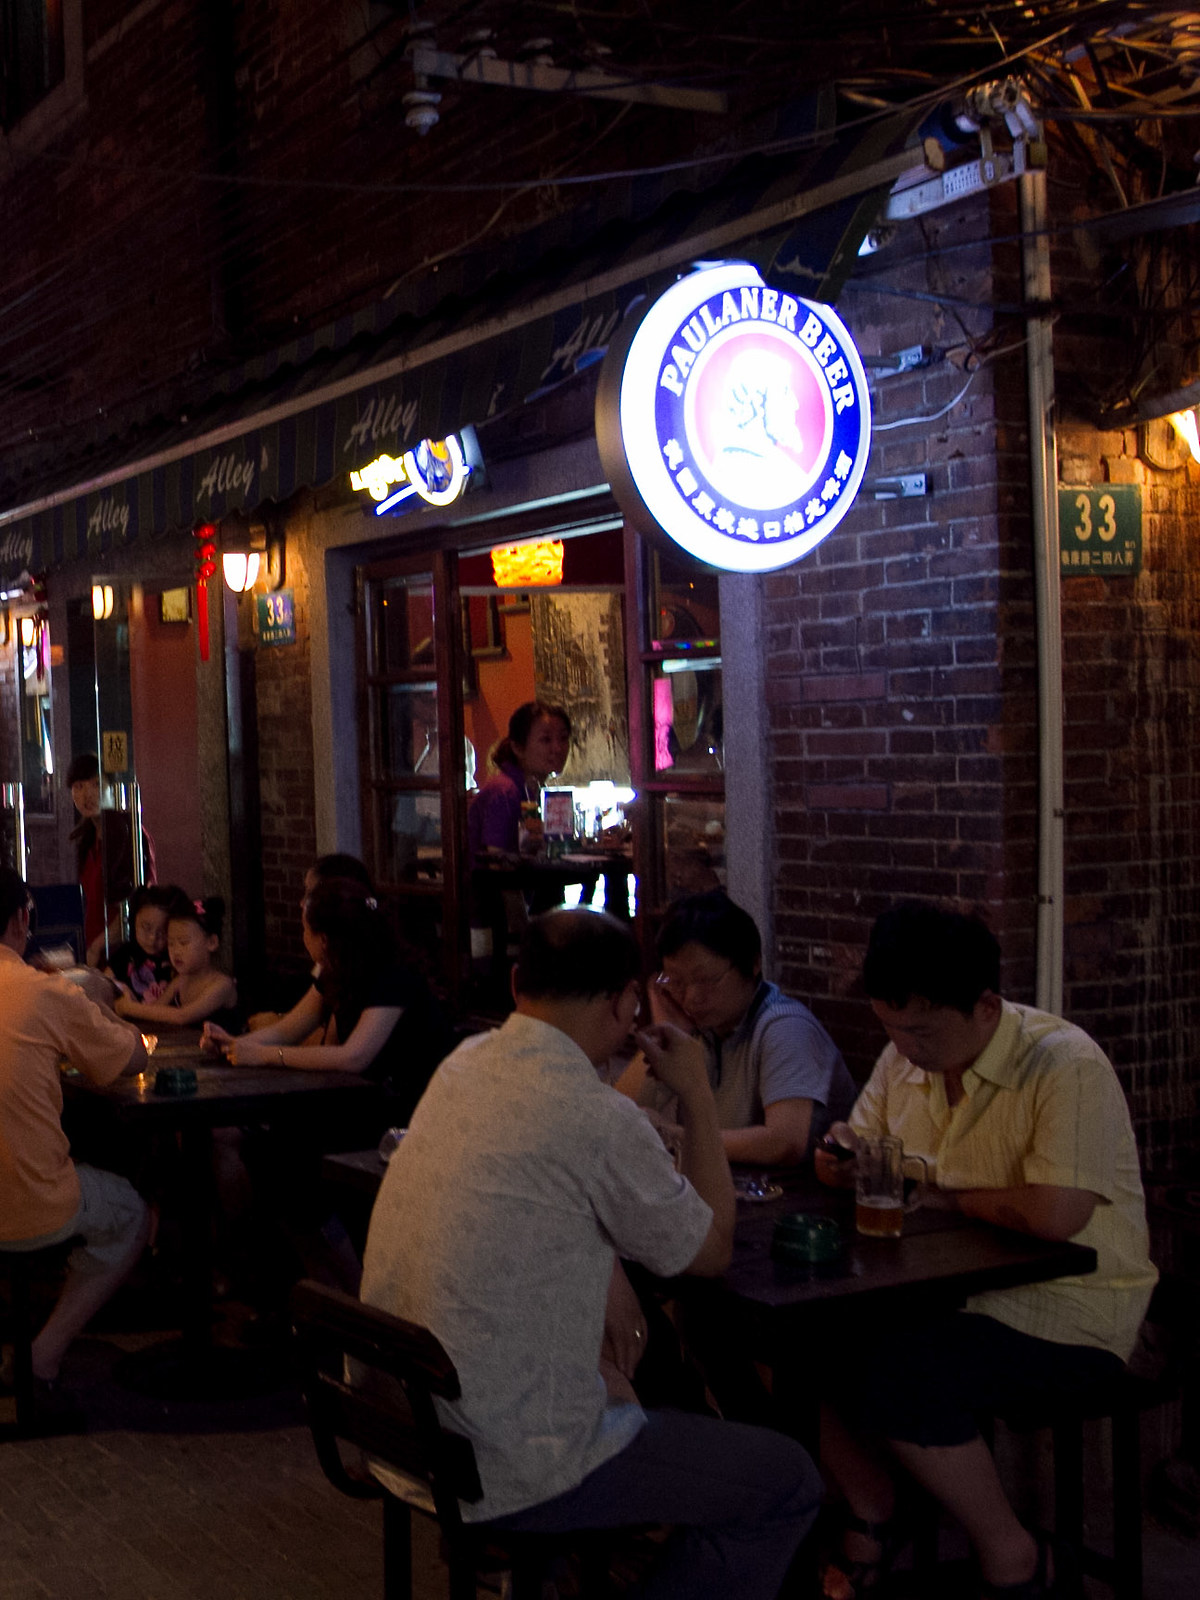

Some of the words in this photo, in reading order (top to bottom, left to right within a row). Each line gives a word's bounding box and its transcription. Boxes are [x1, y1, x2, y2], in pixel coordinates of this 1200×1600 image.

[540, 307, 619, 381] All
[660, 286, 799, 398] PAULANER
[799, 309, 855, 416] BEER
[343, 392, 418, 453] Alley
[195, 451, 256, 503] Alley
[81, 497, 130, 539] Alley
[1074, 493, 1117, 542] 33
[266, 595, 284, 628] 33
